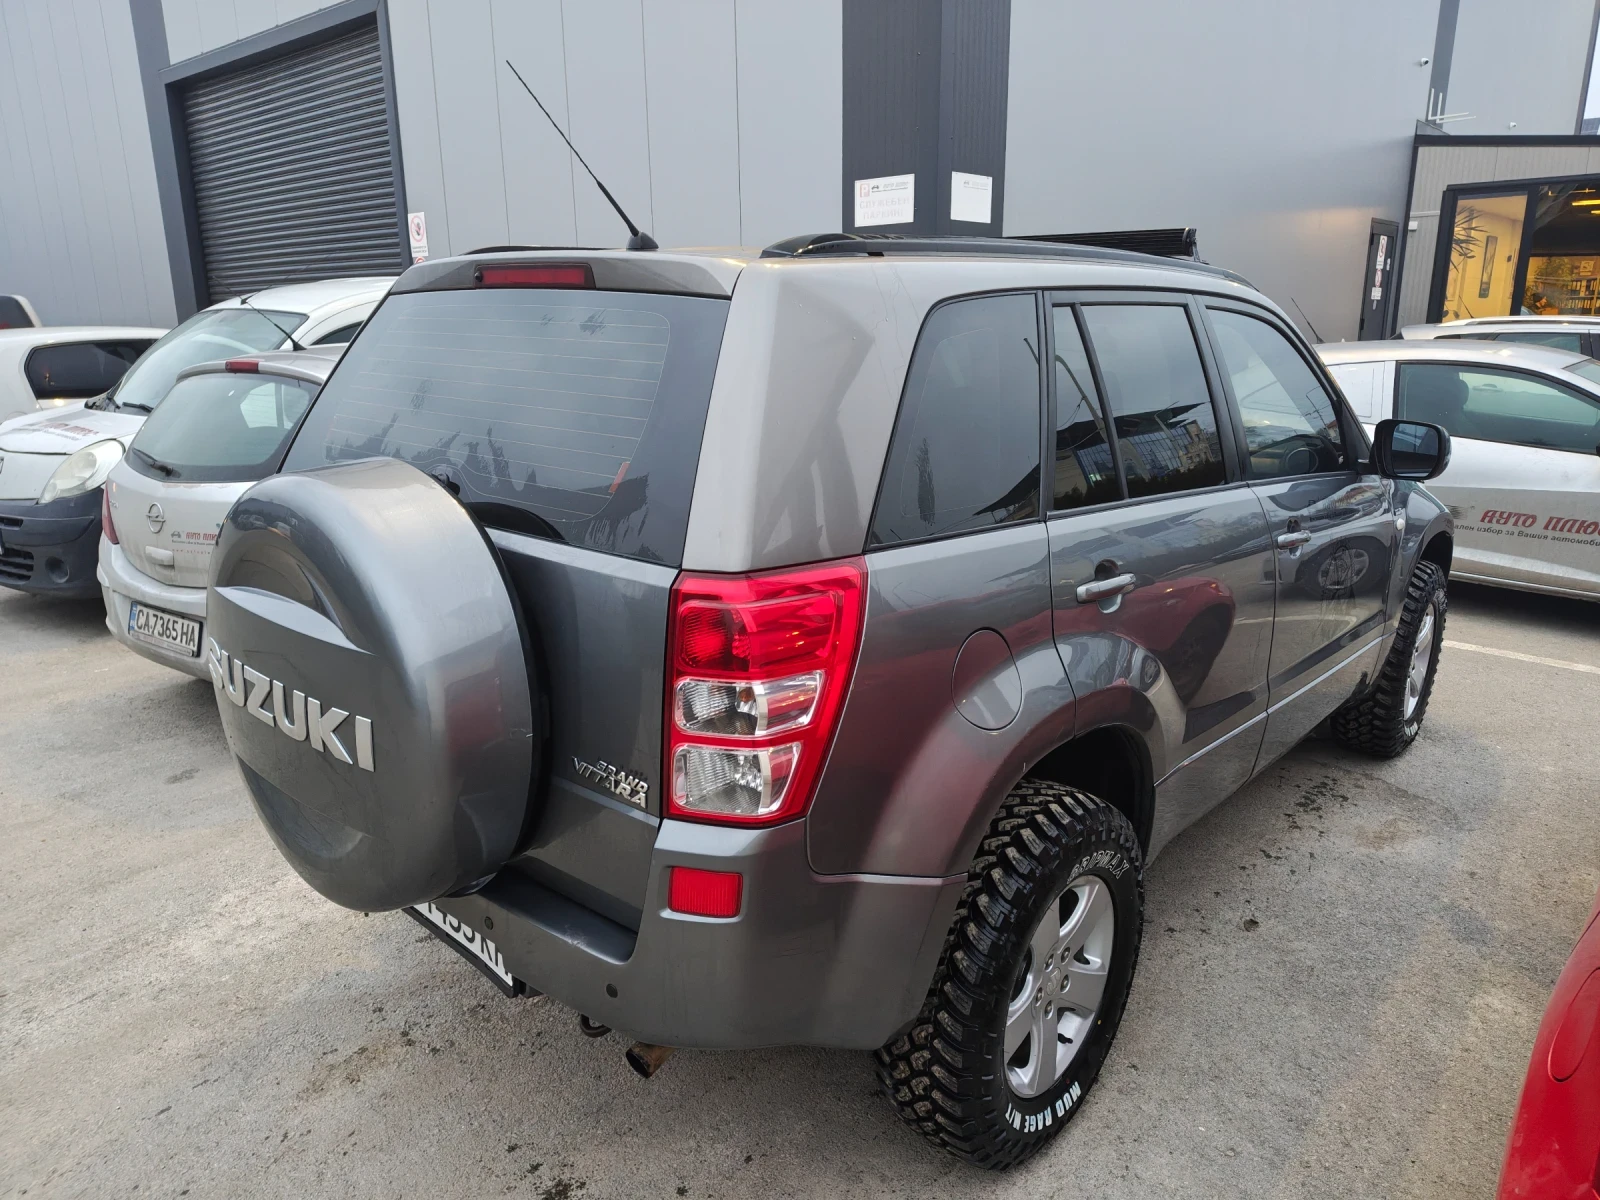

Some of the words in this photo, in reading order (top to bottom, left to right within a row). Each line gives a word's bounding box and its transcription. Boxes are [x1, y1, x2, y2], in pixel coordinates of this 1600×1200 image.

[860, 196, 911, 209] СЛУЖЕБЕН
[1480, 509, 1538, 528] АУТО
[1543, 516, 1600, 536] ПЛЮ
[1477, 526, 1503, 536] избор
[1517, 530, 1549, 540] Вашия
[1551, 535, 1600, 547] автомоби
[208, 636, 375, 773] SUZUKI
[596, 760, 648, 793] GRAND
[1055, 1081, 1081, 1118] MUD
[1023, 1106, 1053, 1133] RAGE
